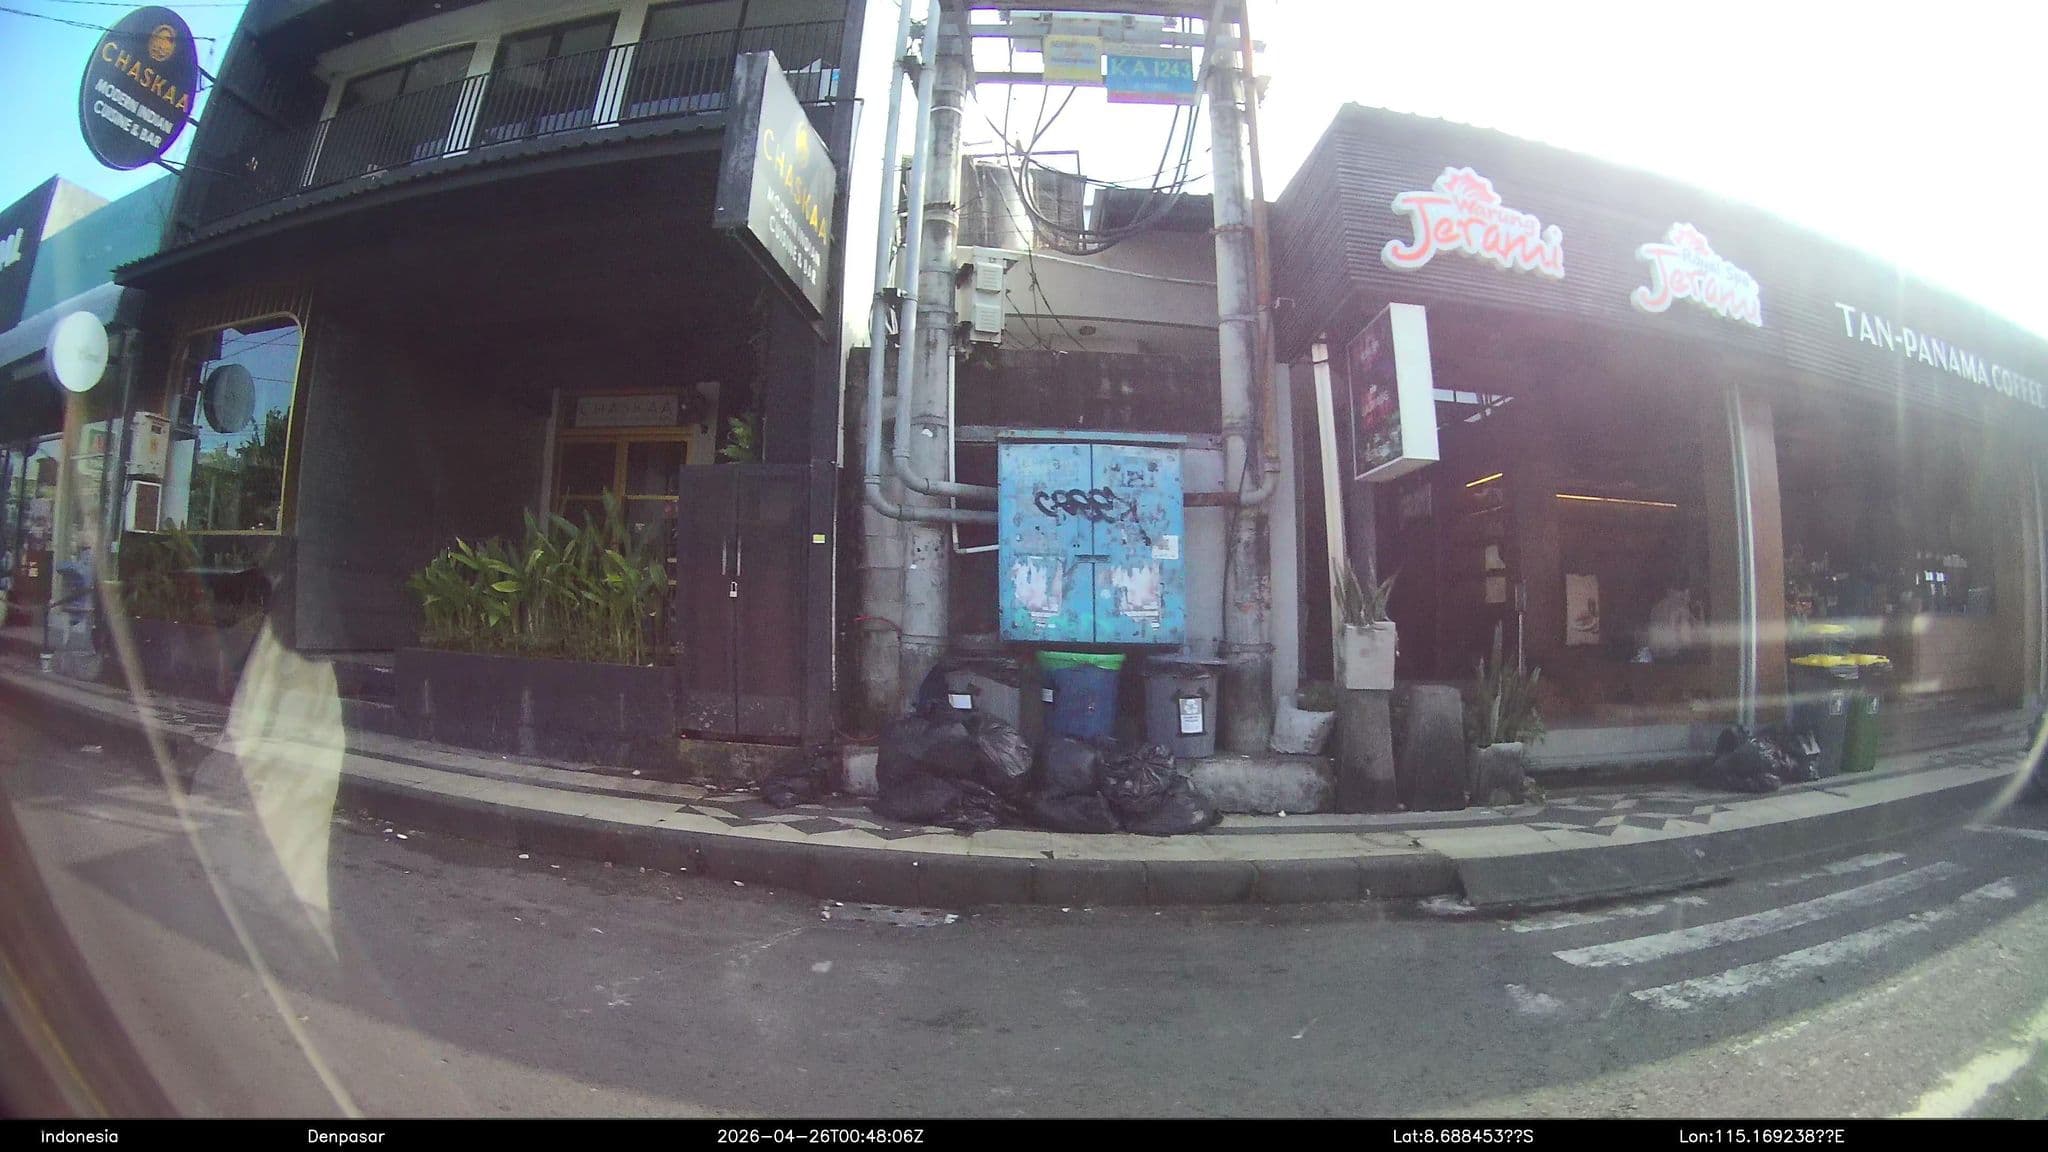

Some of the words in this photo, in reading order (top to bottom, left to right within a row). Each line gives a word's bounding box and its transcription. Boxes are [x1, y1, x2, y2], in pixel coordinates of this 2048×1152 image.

[95, 79, 138, 114] MODERN
[137, 104, 173, 134] INDIAN
[103, 42, 189, 112] CHASKAA
[94, 100, 133, 132] CUISINE
[140, 128, 162, 148] BAR
[763, 128, 828, 246] CHASKAA
[766, 185, 798, 236] MODERN
[1390, 195, 1564, 272] Jerami
[803, 258, 817, 286] BAR
[1639, 247, 1760, 321] Jerami
[1834, 301, 1991, 388] TAN-PANAMA
[1990, 363, 2047, 410] COFFEE
